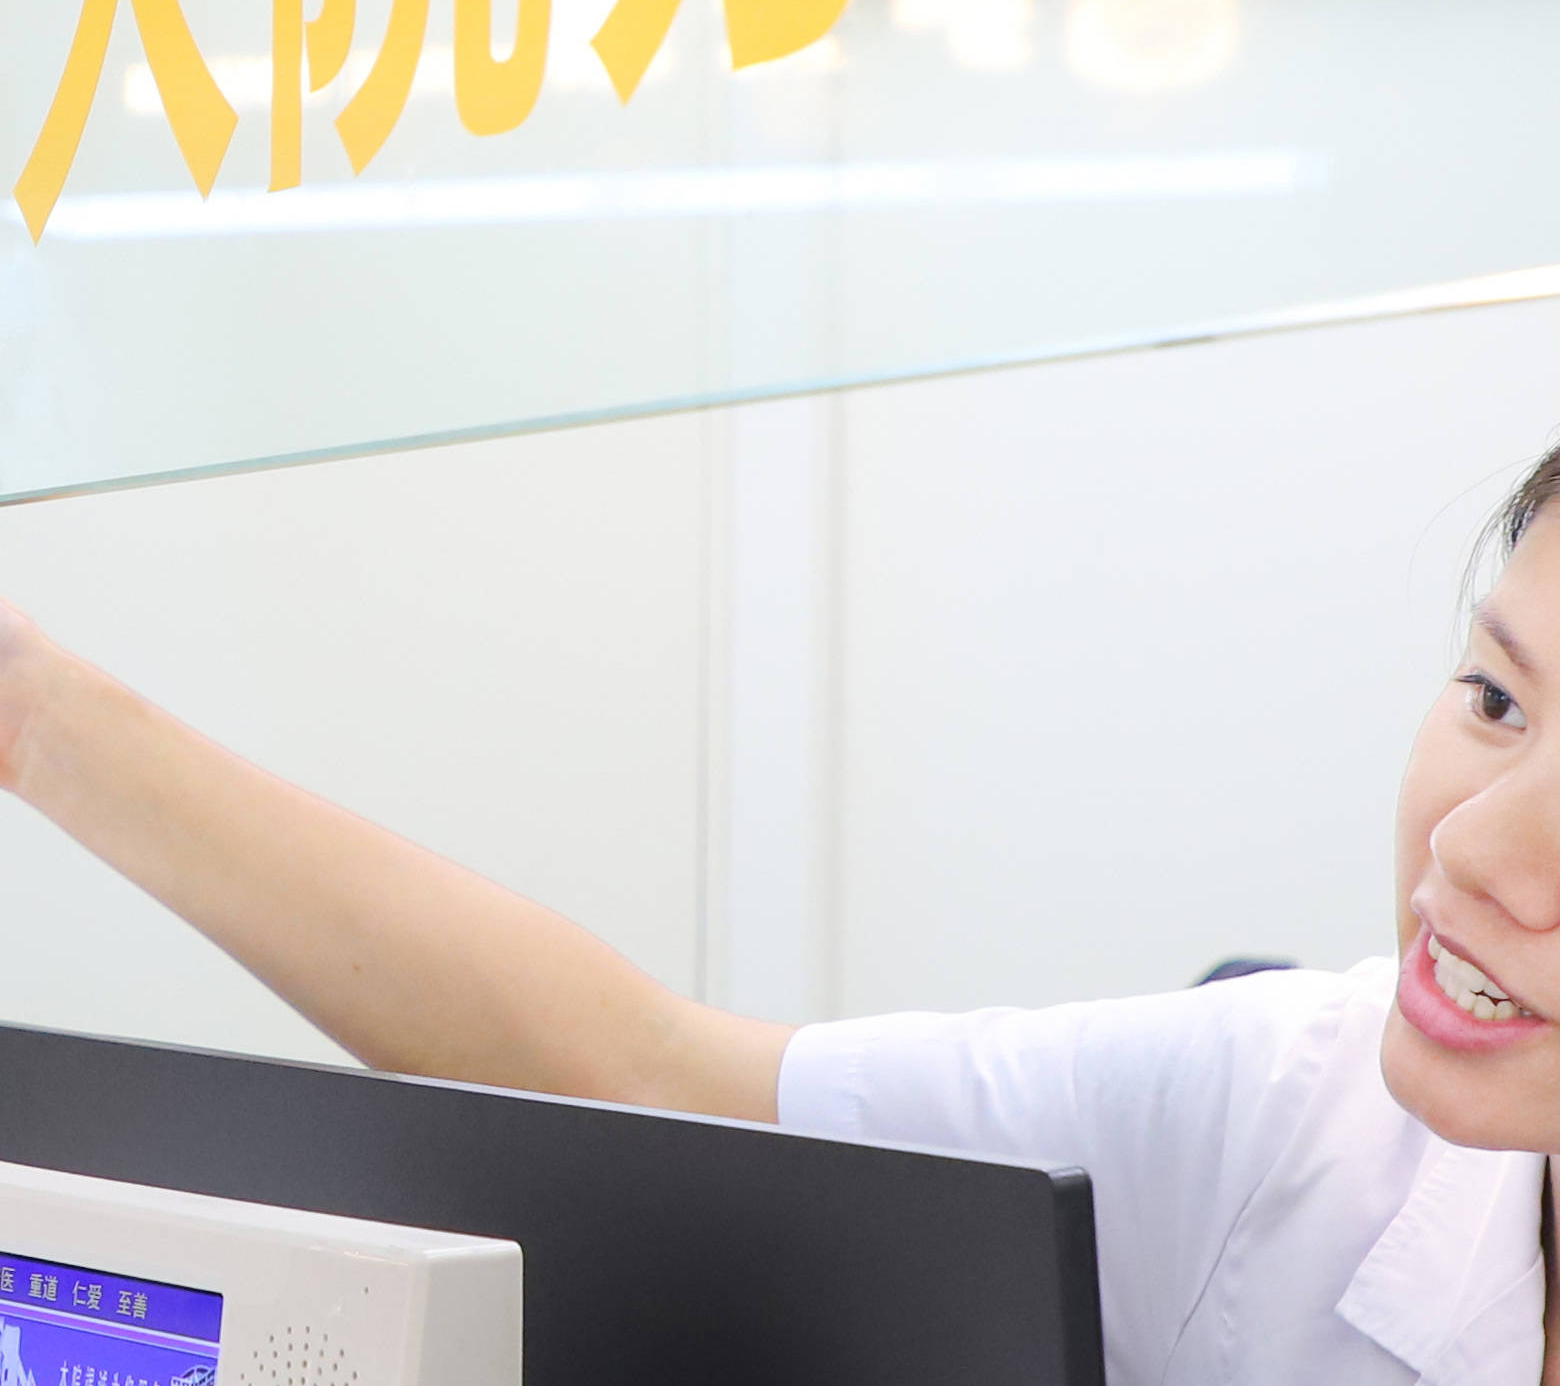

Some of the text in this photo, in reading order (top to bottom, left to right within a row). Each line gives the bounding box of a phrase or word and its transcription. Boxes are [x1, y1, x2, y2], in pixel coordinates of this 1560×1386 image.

[28, 1273, 59, 1302] 重道
[72, 1281, 102, 1311] 仁爱
[117, 1290, 148, 1320] 至善
